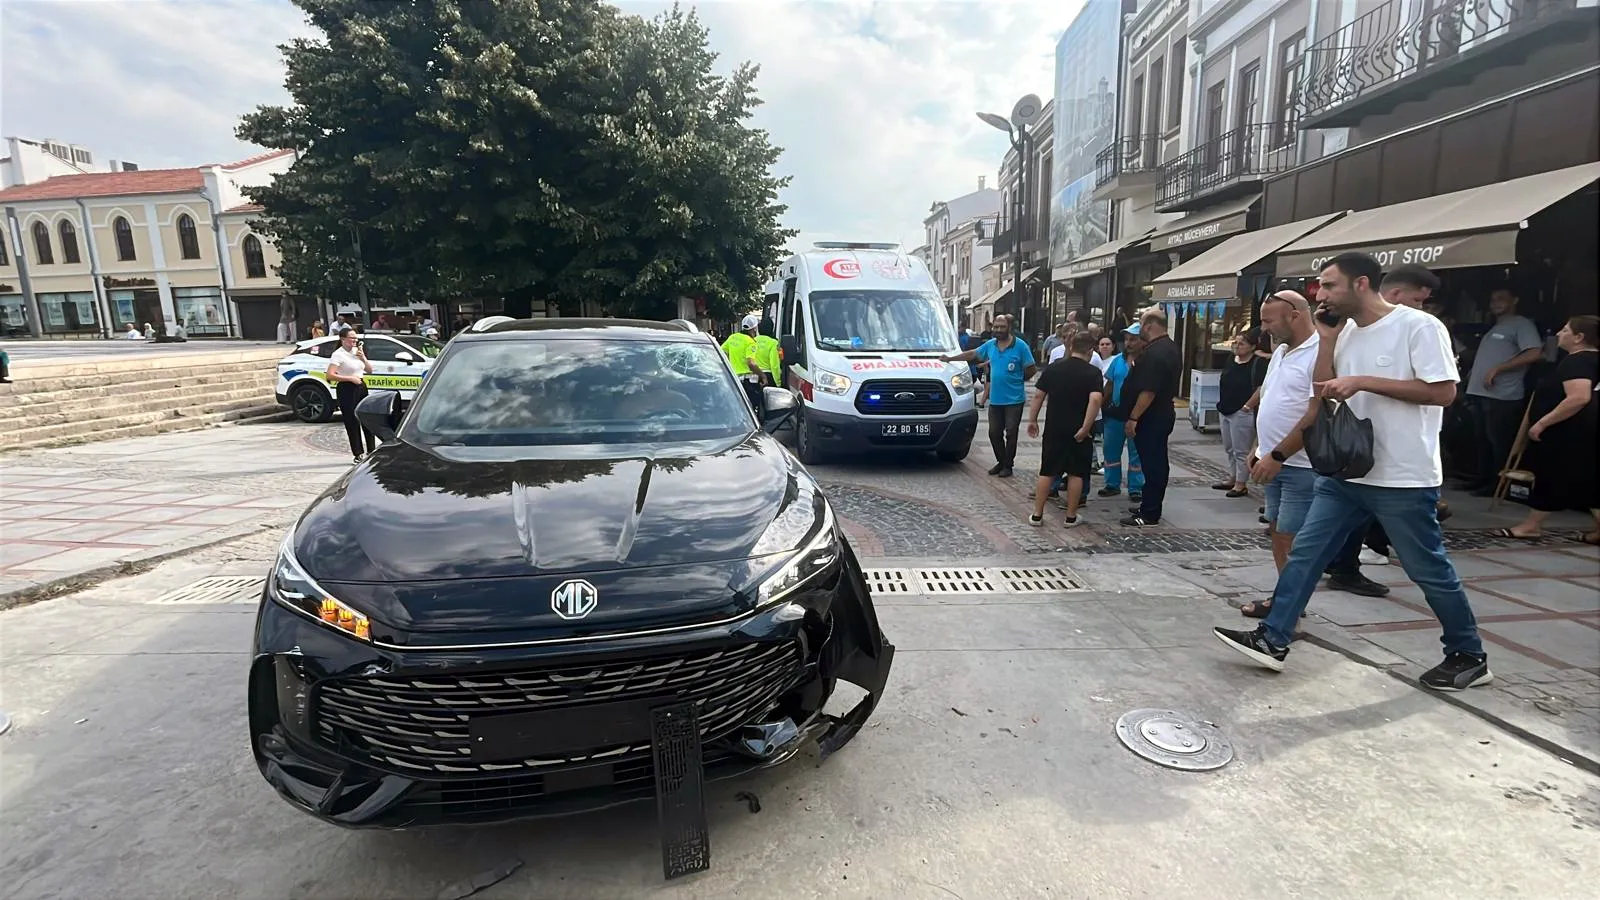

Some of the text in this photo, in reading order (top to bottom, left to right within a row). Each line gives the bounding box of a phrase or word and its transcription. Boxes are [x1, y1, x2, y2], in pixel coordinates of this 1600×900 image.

[1167, 223, 1220, 243] AYTAÇ MÜCEVHERAT
[1402, 245, 1444, 264] STOP
[1167, 283, 1215, 297] ARMAĞAN BÜFE
[368, 378, 419, 388] TRAFİK POLİSİ
[886, 424, 897, 433] 22
[900, 424, 911, 433] BD
[555, 582, 594, 615] MG
